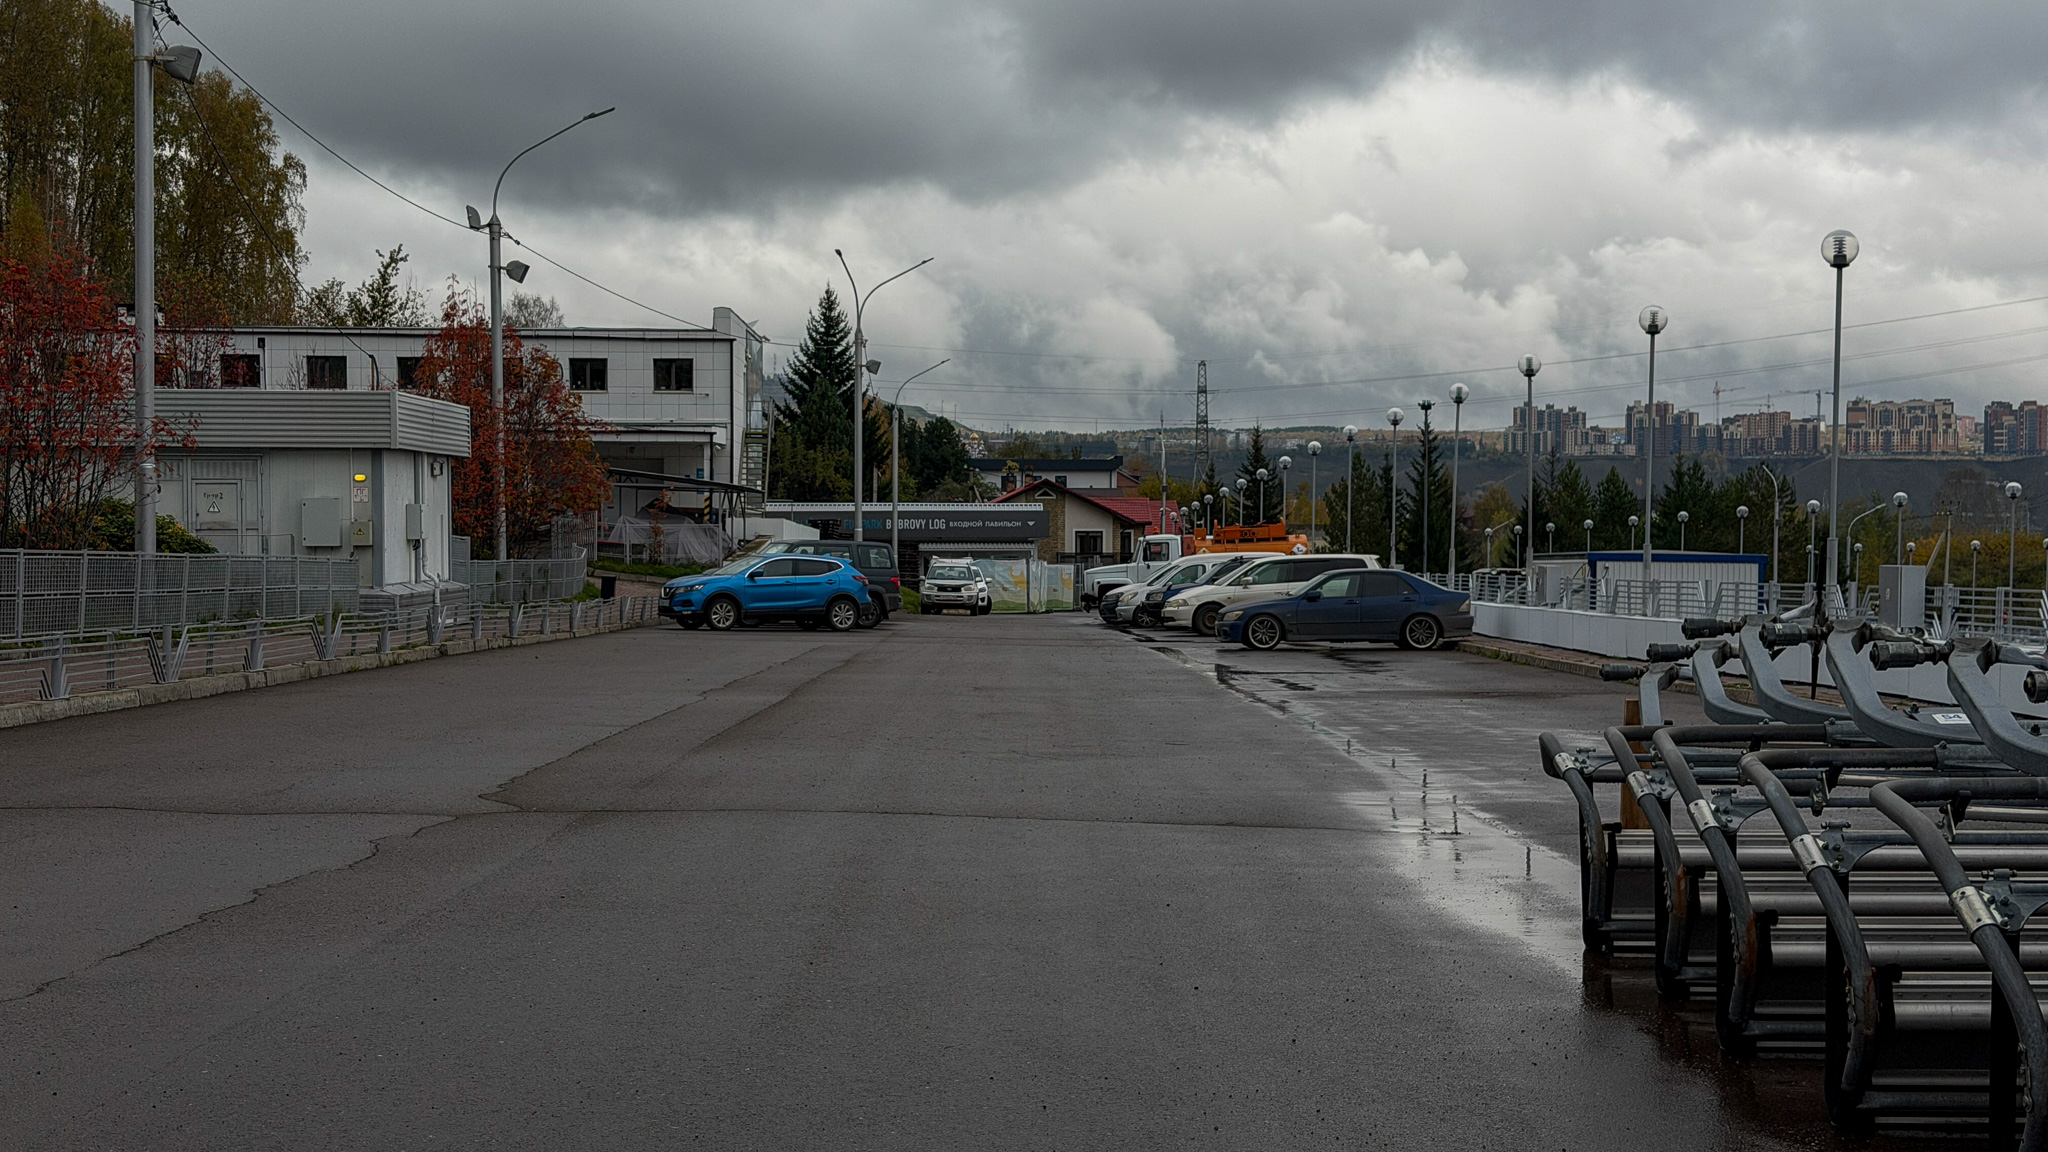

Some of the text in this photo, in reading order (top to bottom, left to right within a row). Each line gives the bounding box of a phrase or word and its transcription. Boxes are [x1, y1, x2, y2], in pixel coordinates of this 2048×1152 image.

[886, 518, 926, 530] BBROVY
[929, 518, 946, 530] LOG
[949, 519, 983, 528] ВХОДНОЙ
